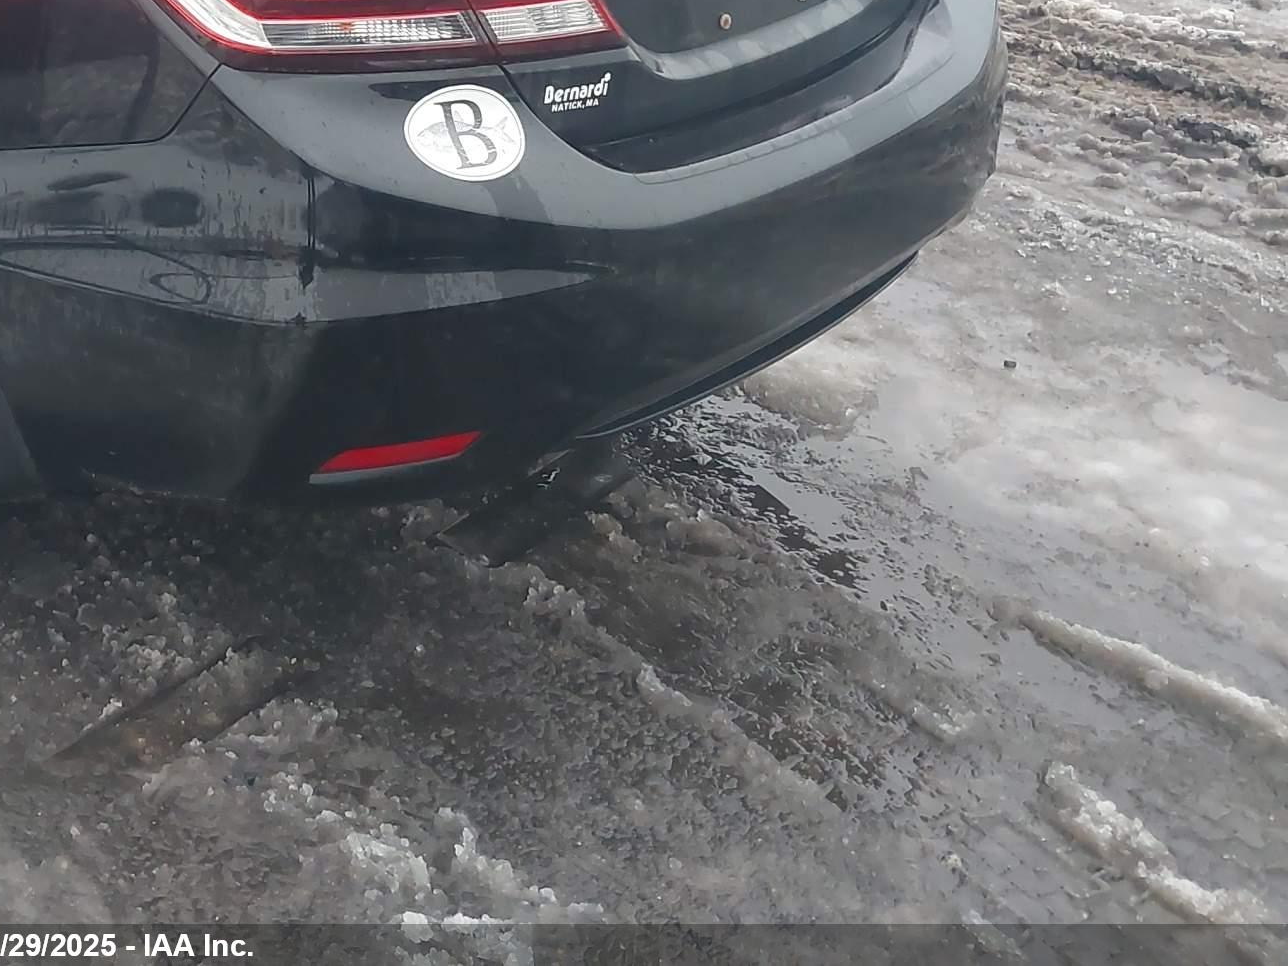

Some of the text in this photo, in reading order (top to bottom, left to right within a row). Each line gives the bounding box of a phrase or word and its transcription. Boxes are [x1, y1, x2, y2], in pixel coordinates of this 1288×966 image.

[543, 71, 612, 105] Bernardi
[551, 97, 600, 113] NATICK, MA
[433, 99, 498, 171] B
